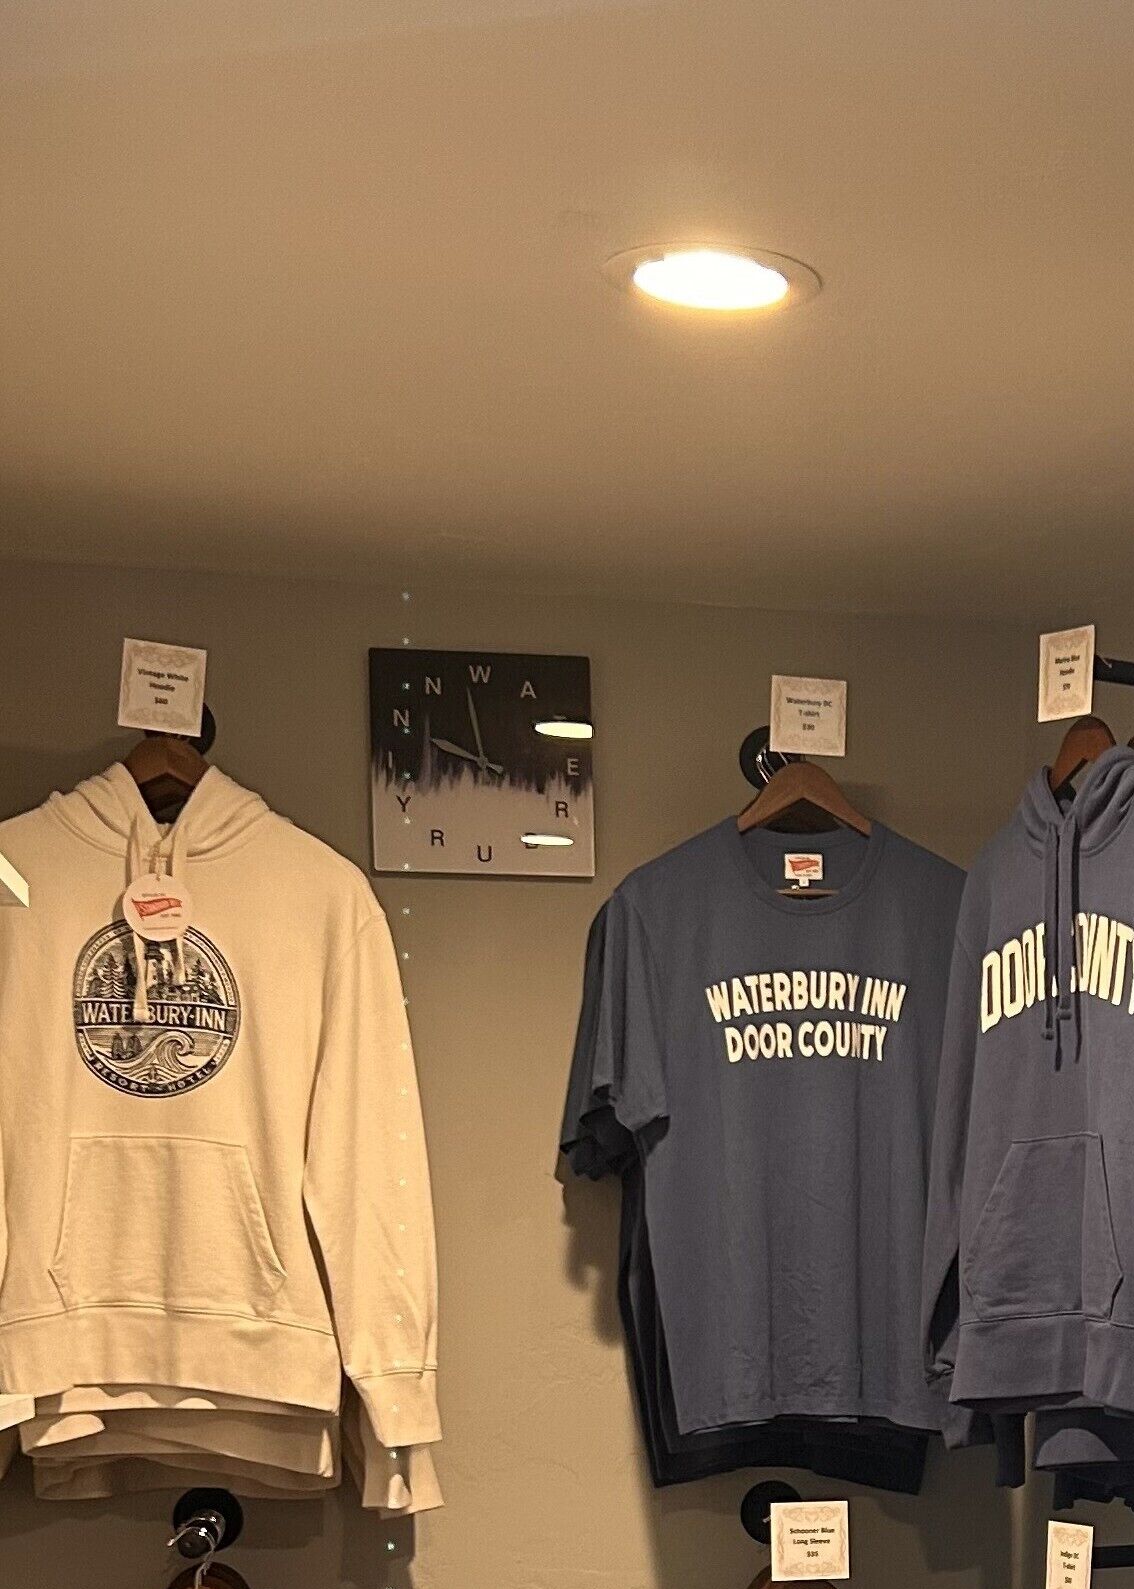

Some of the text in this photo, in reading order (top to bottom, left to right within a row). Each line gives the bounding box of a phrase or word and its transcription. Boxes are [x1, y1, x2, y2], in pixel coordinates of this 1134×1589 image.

[82, 1002, 226, 1032] WATEBURY-INN
[705, 970, 907, 1023] WATERBURY INN
[724, 1020, 888, 1064] DOOR COUNTY
